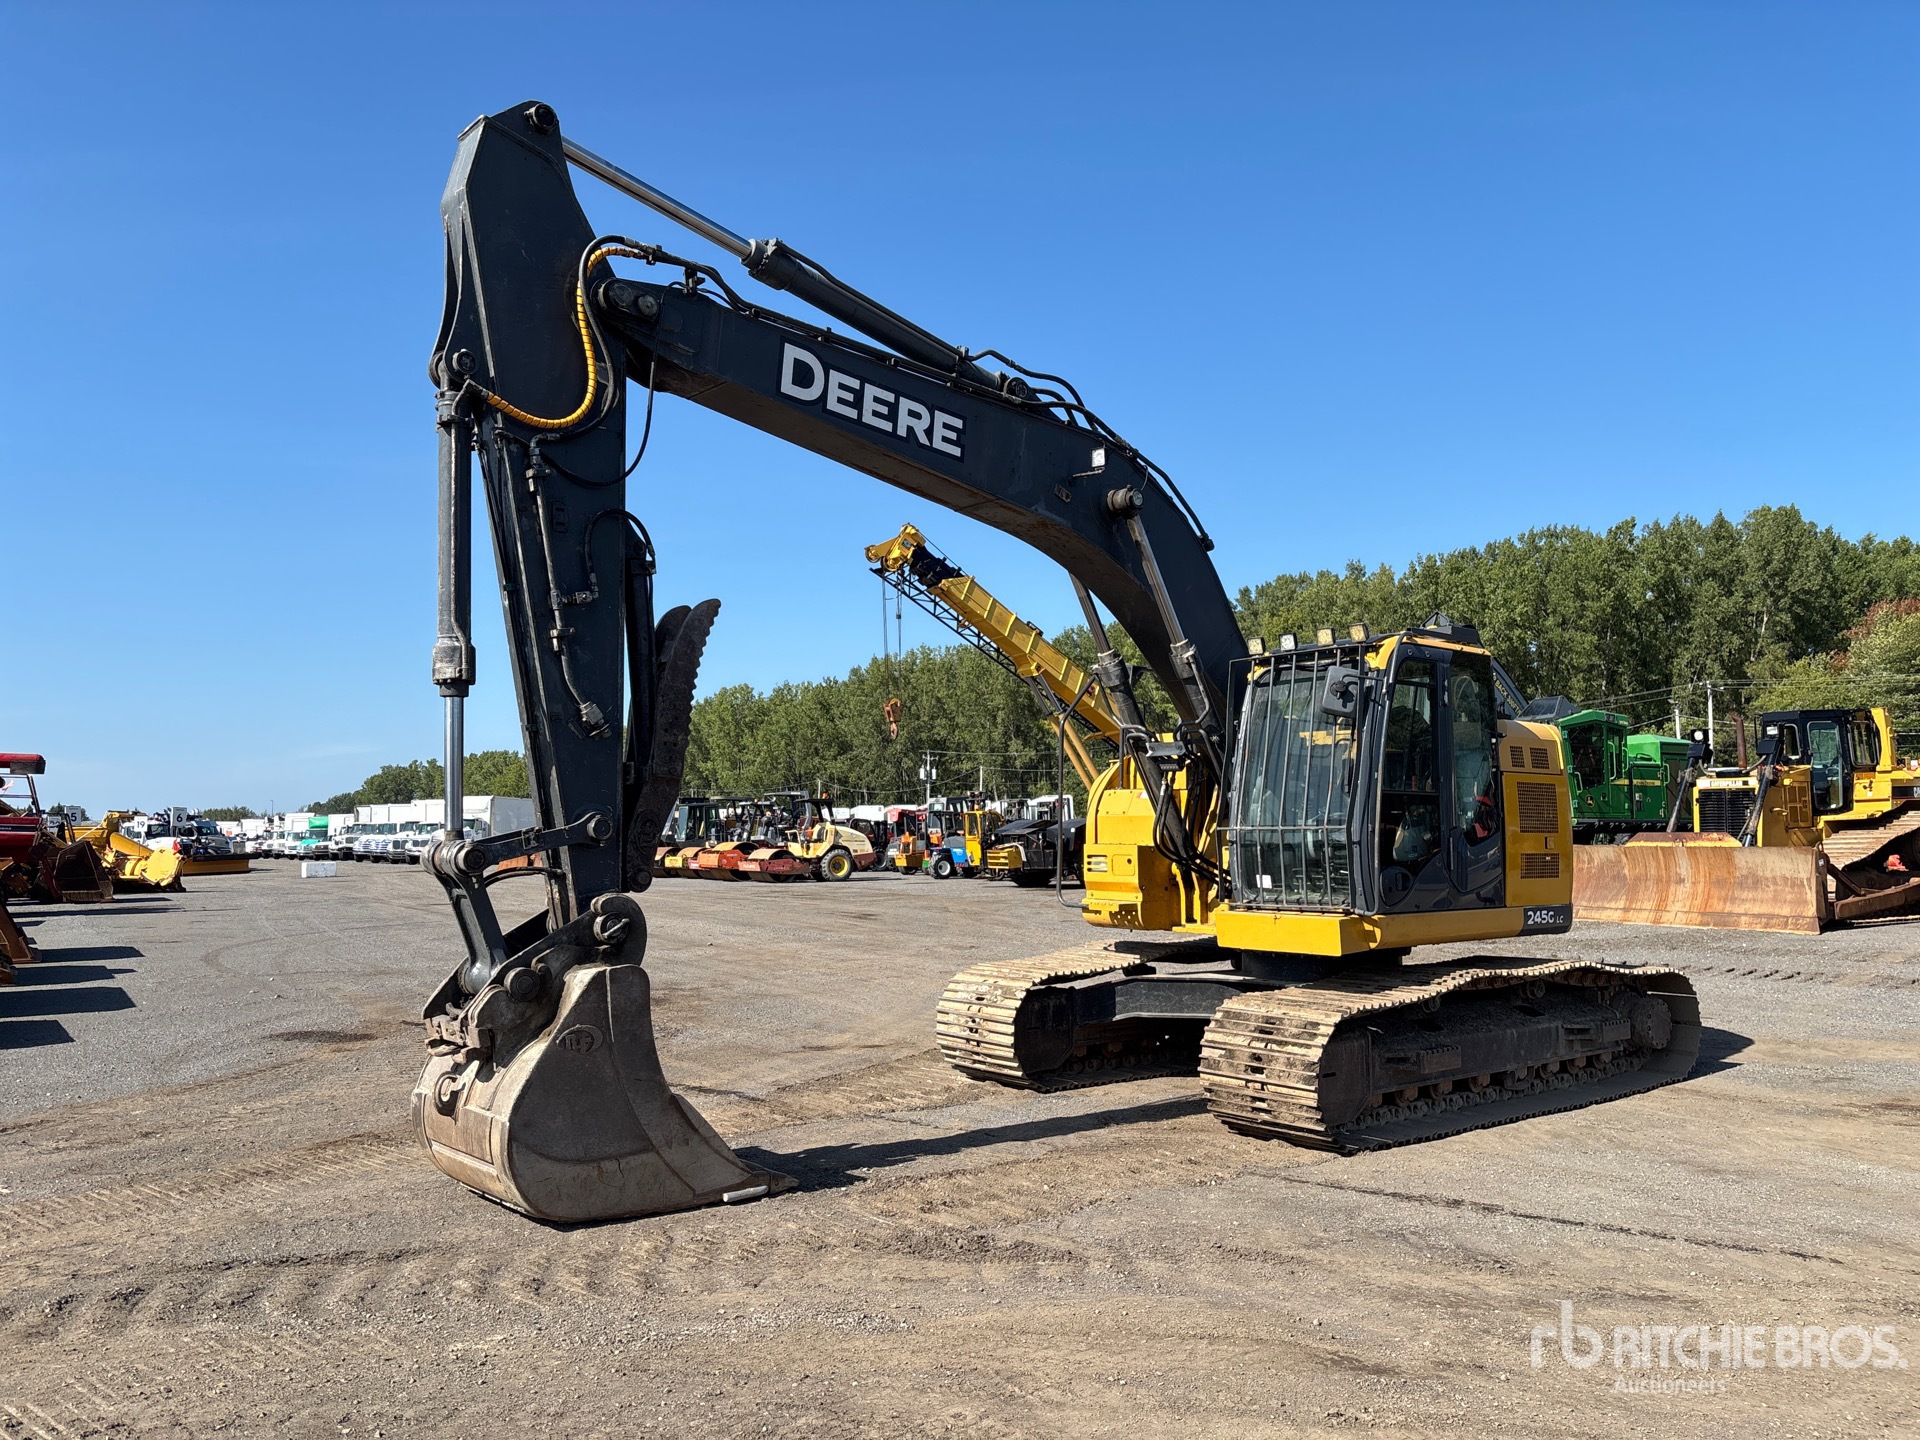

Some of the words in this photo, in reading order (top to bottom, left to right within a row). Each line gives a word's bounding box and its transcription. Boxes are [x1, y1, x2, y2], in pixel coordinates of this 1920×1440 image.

[780, 342, 964, 457] DEERE
[70, 812, 77, 822] 5
[176, 813, 183, 823] 6
[136, 820, 145, 829] 19
[1527, 910, 1555, 925] 245G
[1556, 915, 1564, 923] LC
